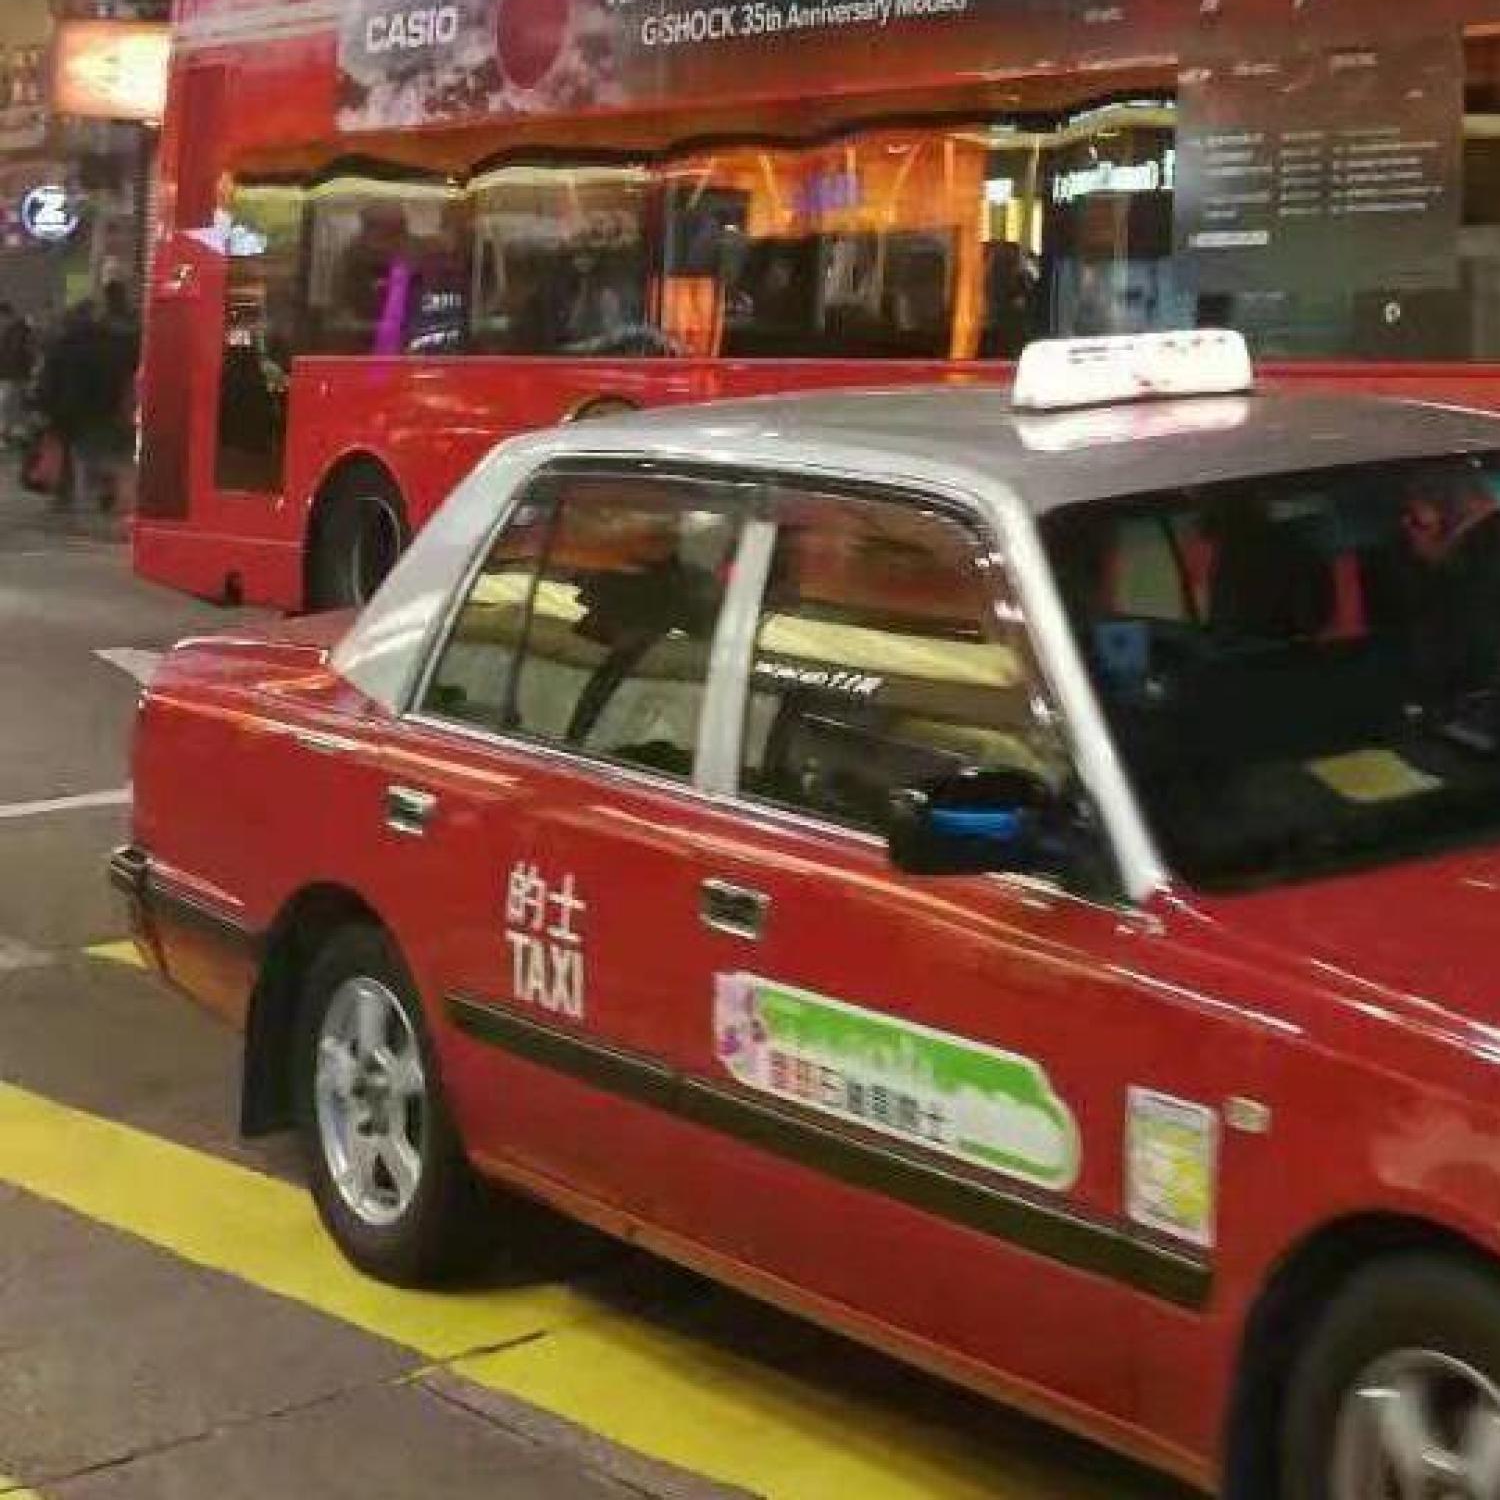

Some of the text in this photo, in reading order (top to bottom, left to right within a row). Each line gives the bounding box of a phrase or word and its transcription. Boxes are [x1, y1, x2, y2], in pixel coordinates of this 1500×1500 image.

[365, 5, 459, 54] CASIO
[739, 2, 782, 37] 35th
[506, 861, 586, 944] 的士
[504, 930, 585, 1019] TAXI
